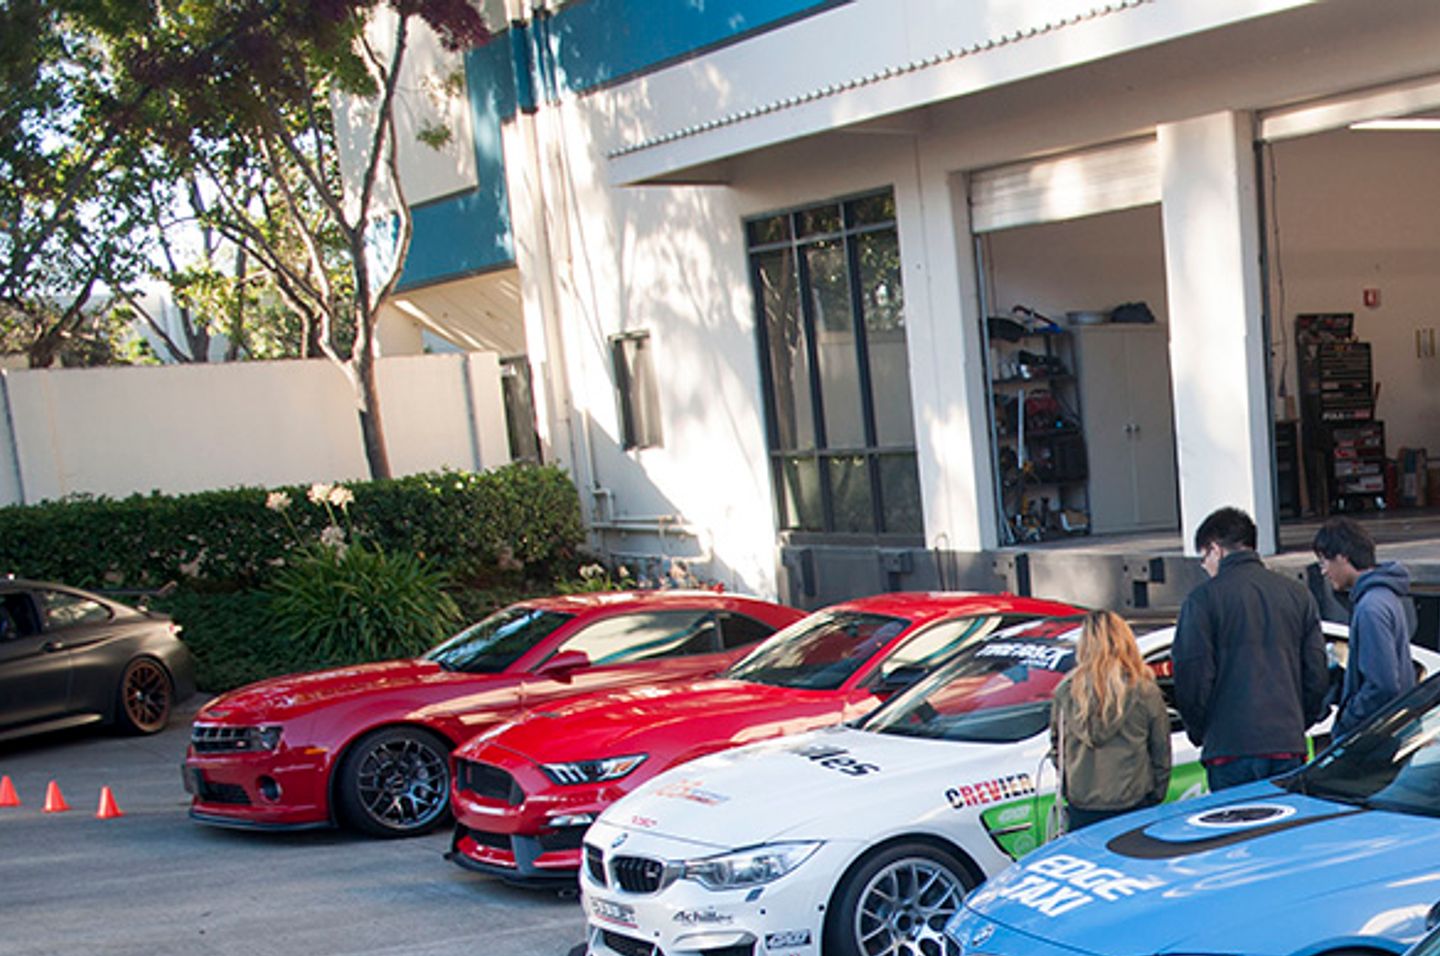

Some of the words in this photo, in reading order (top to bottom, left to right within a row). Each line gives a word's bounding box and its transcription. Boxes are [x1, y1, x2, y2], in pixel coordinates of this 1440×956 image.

[945, 773, 1036, 809] CREVIER
[998, 875, 1094, 917] TAXI
[1026, 854, 1158, 901] EDGE
